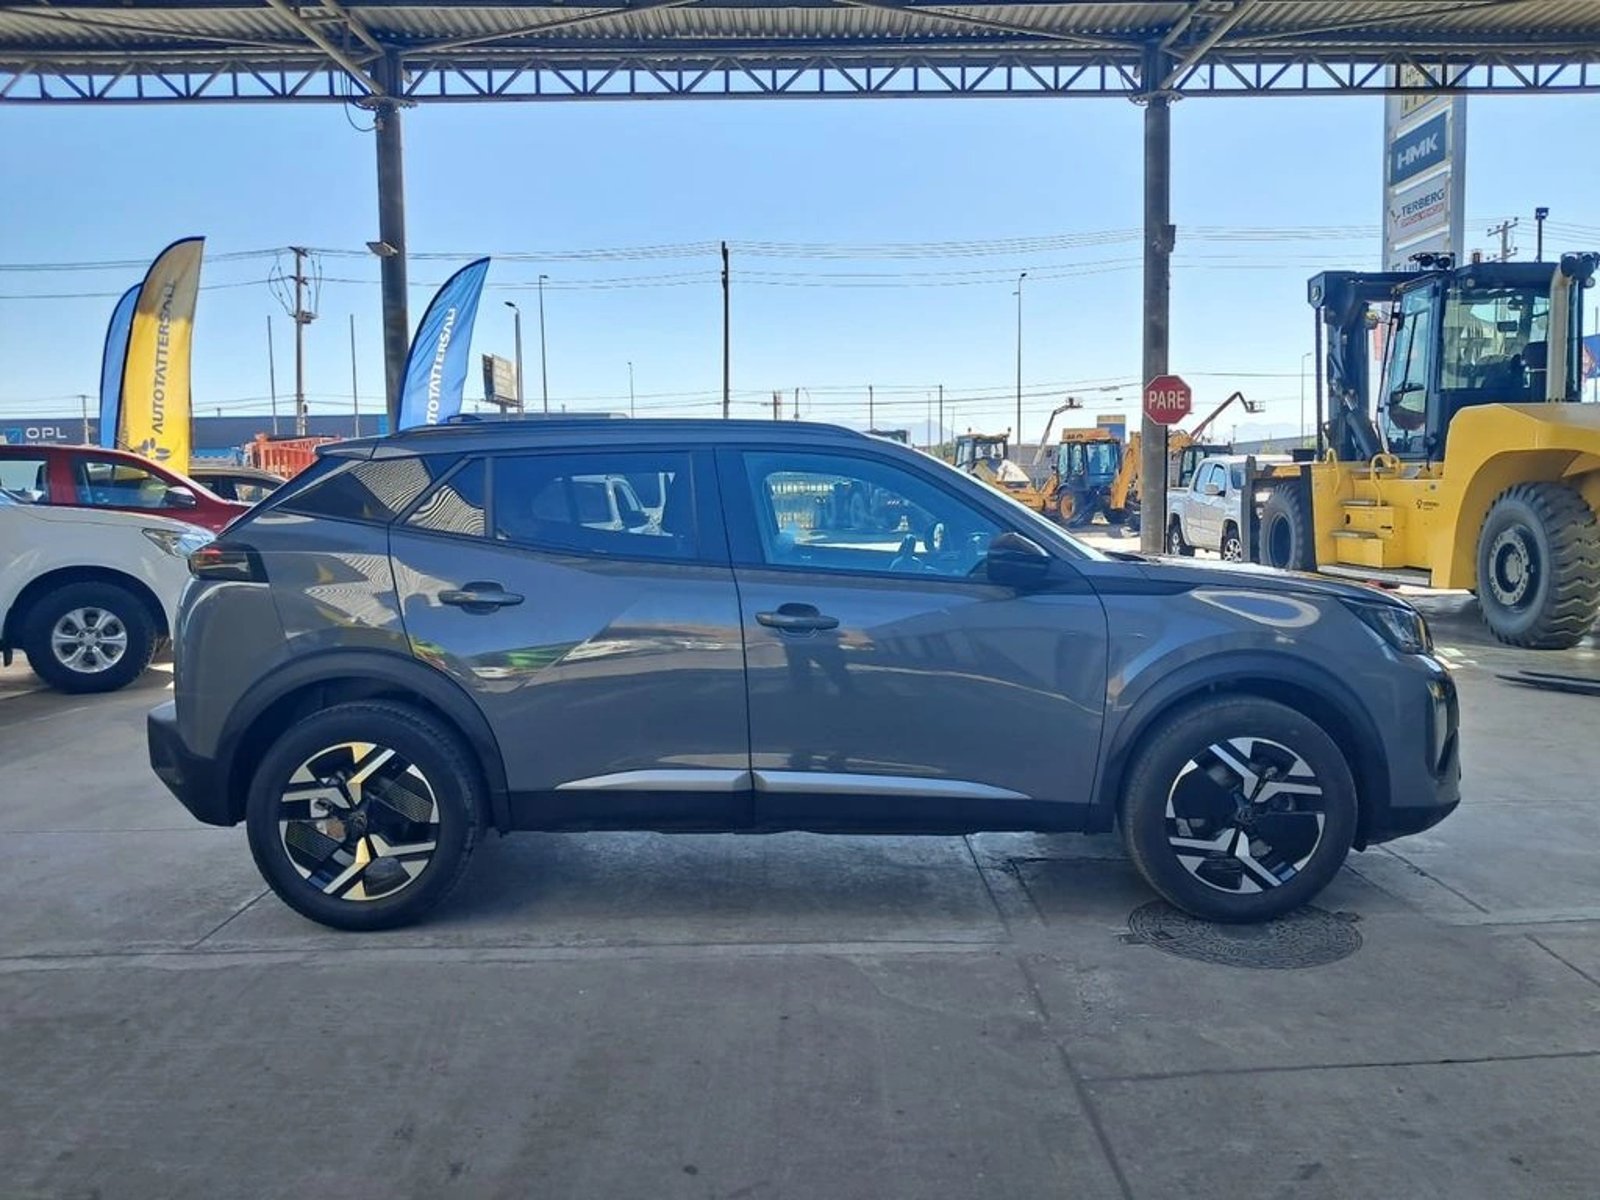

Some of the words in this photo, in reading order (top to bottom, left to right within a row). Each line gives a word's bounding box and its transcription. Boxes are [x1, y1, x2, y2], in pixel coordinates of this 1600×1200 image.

[1397, 131, 1439, 170] HMK
[1401, 187, 1445, 218] TERBERG
[152, 279, 176, 435] AUTOTATTERSALL
[1148, 390, 1186, 410] PARE
[26, 427, 68, 439] OPL
